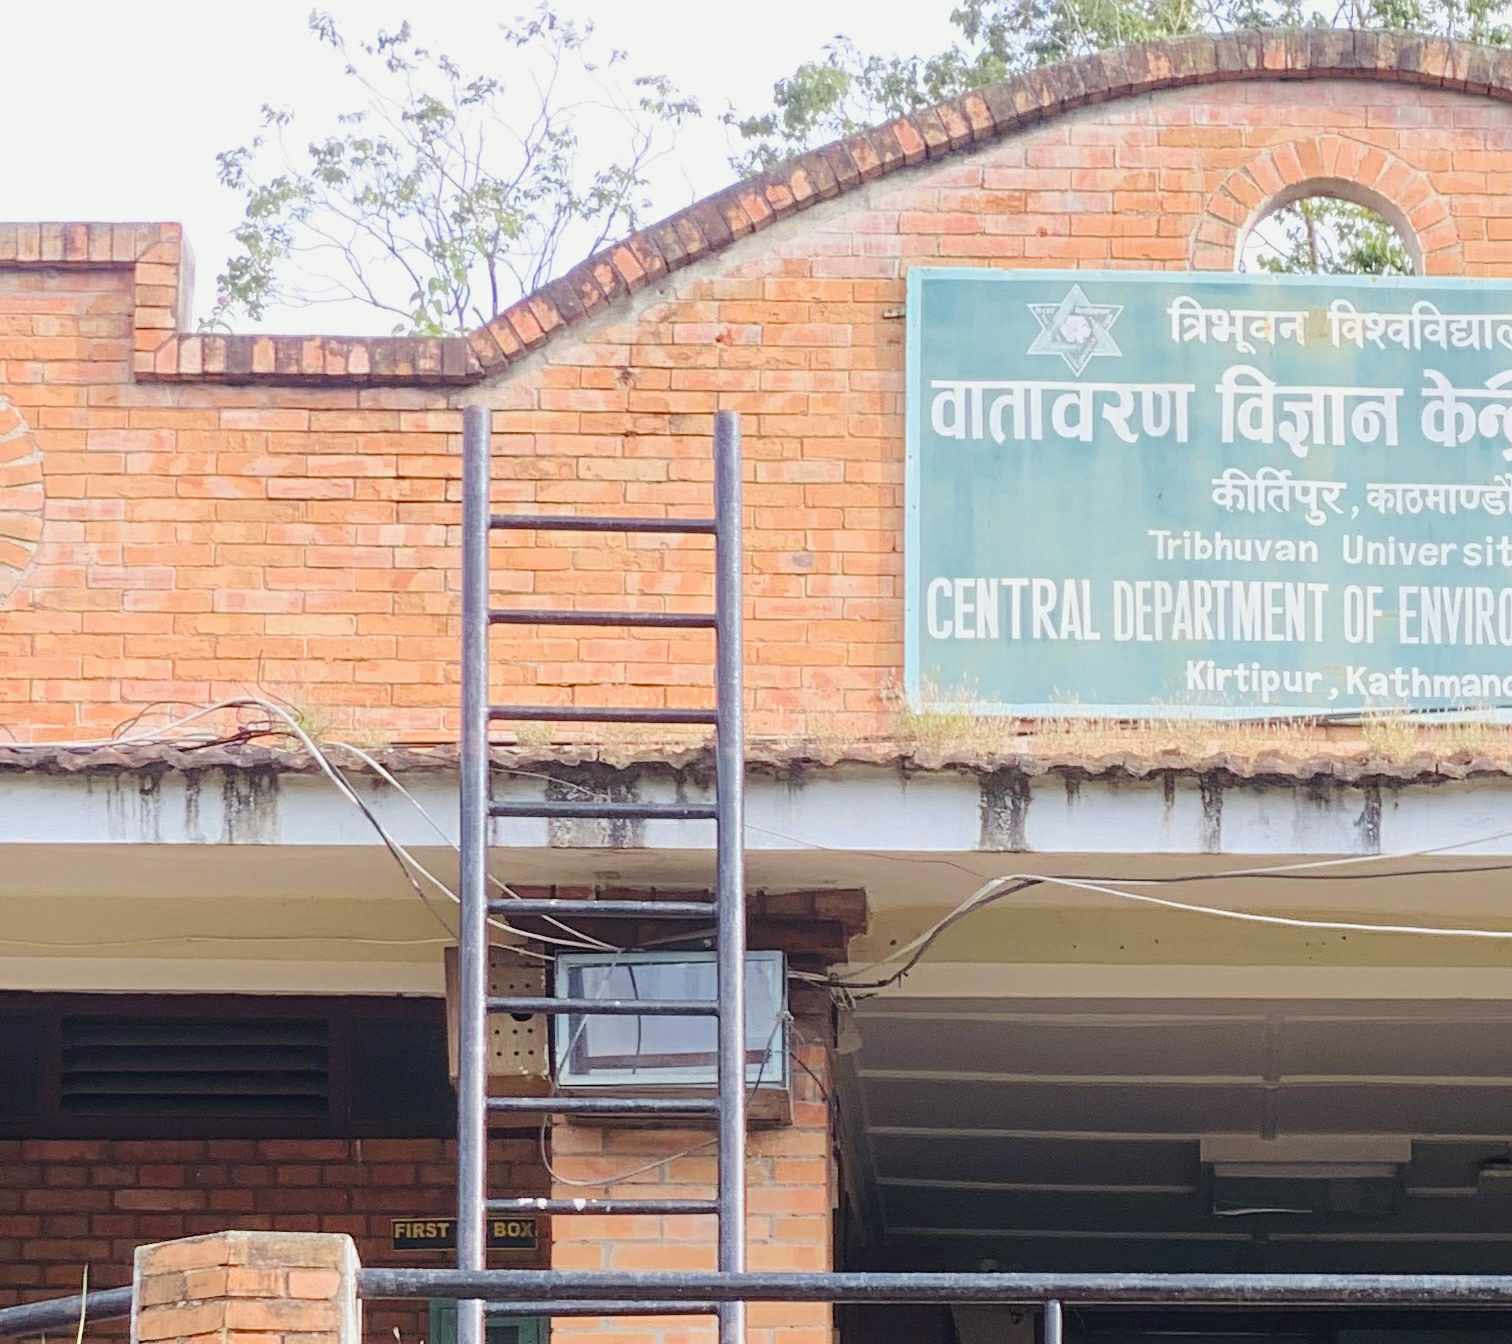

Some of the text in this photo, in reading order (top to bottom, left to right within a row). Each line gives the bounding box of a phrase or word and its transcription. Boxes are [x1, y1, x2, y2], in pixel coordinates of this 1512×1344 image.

[930, 380, 1195, 445] वातावरण
[1215, 364, 1404, 458] विज्ञान
[1148, 530, 1319, 563] Tribhuvan
[927, 578, 1100, 640] CENTRAL
[1113, 580, 1329, 643] DEPARTMENT
[1343, 584, 1383, 644] OF
[394, 1222, 534, 1239] FIRST BOX
